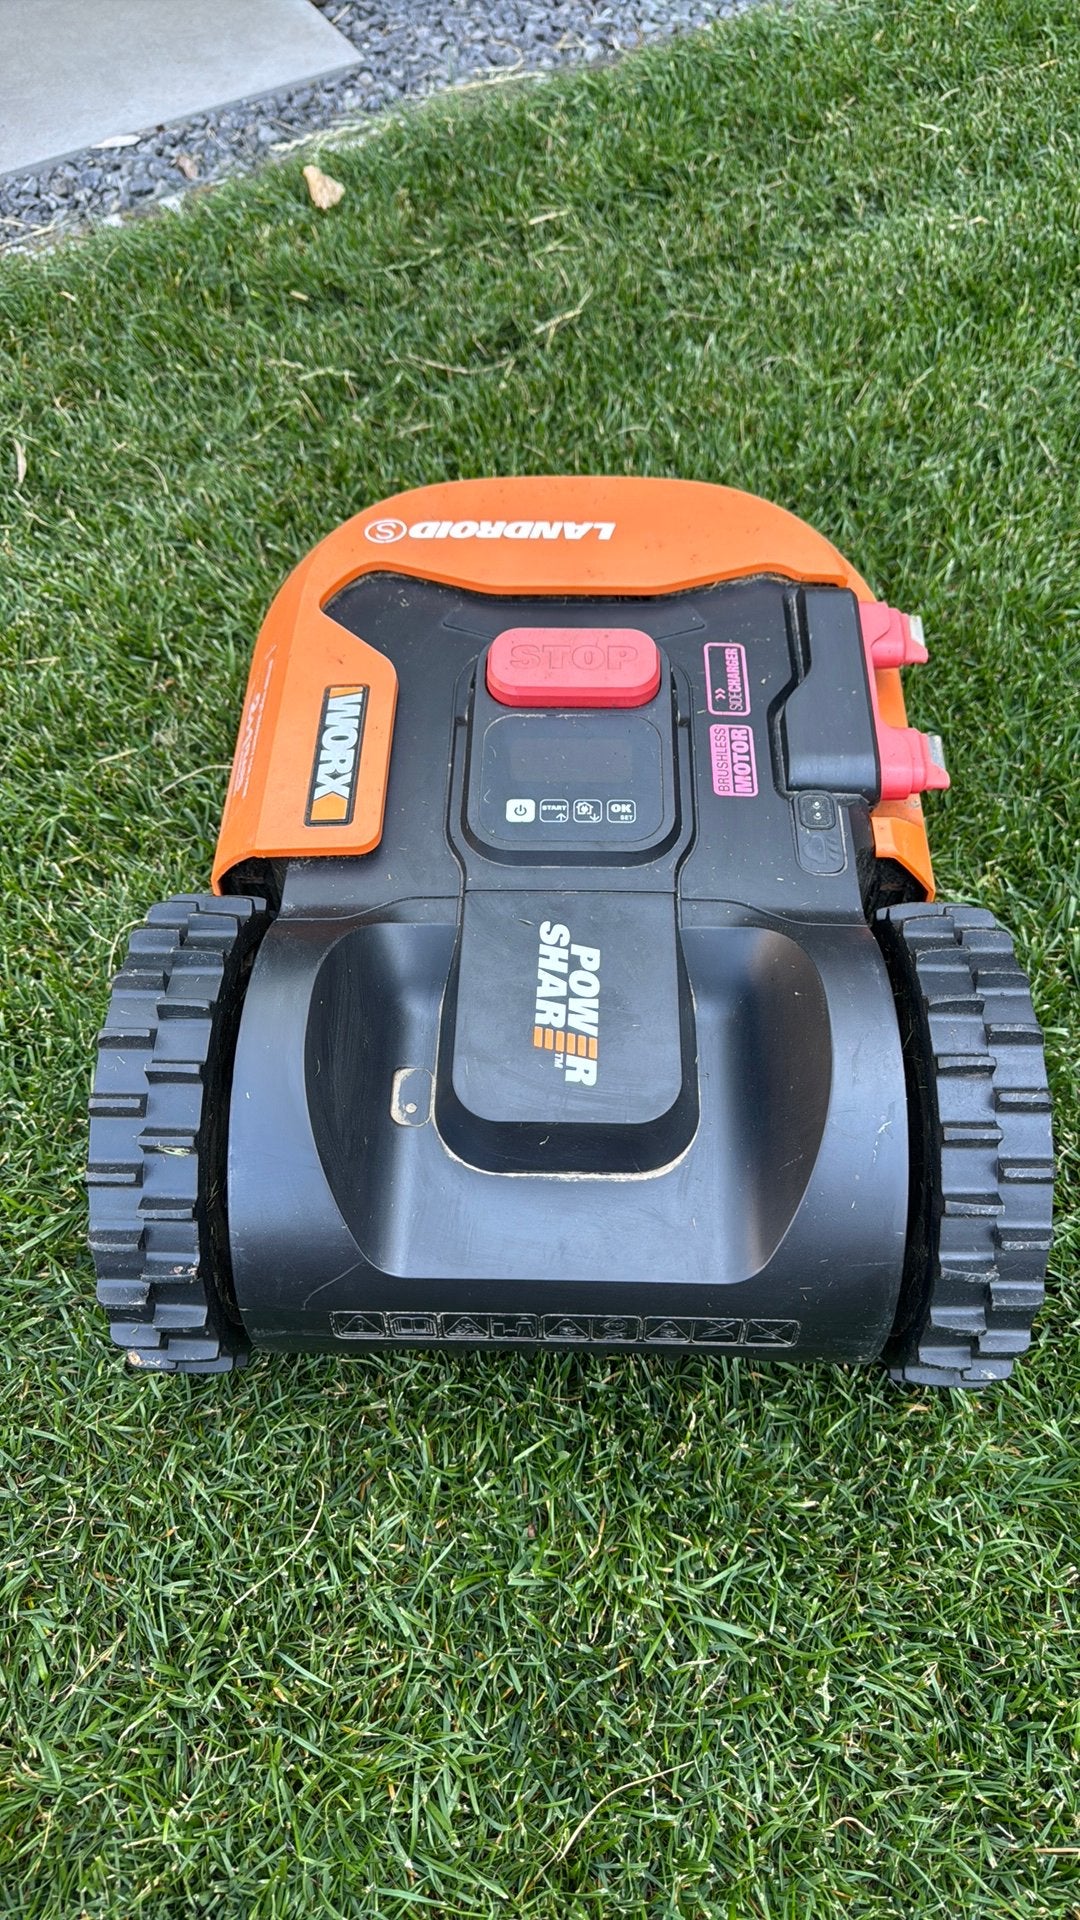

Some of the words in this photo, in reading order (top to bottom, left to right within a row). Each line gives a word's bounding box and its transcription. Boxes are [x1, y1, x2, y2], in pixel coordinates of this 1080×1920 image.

[409, 520, 616, 540] LANDROID
[509, 644, 639, 671] STOP
[313, 692, 363, 801] WORX
[714, 727, 730, 792] BRUSHLESS
[730, 728, 753, 793] MOTOR
[610, 803, 632, 813] OK
[533, 920, 571, 1053] SHARE
[565, 943, 601, 1087] POWER
